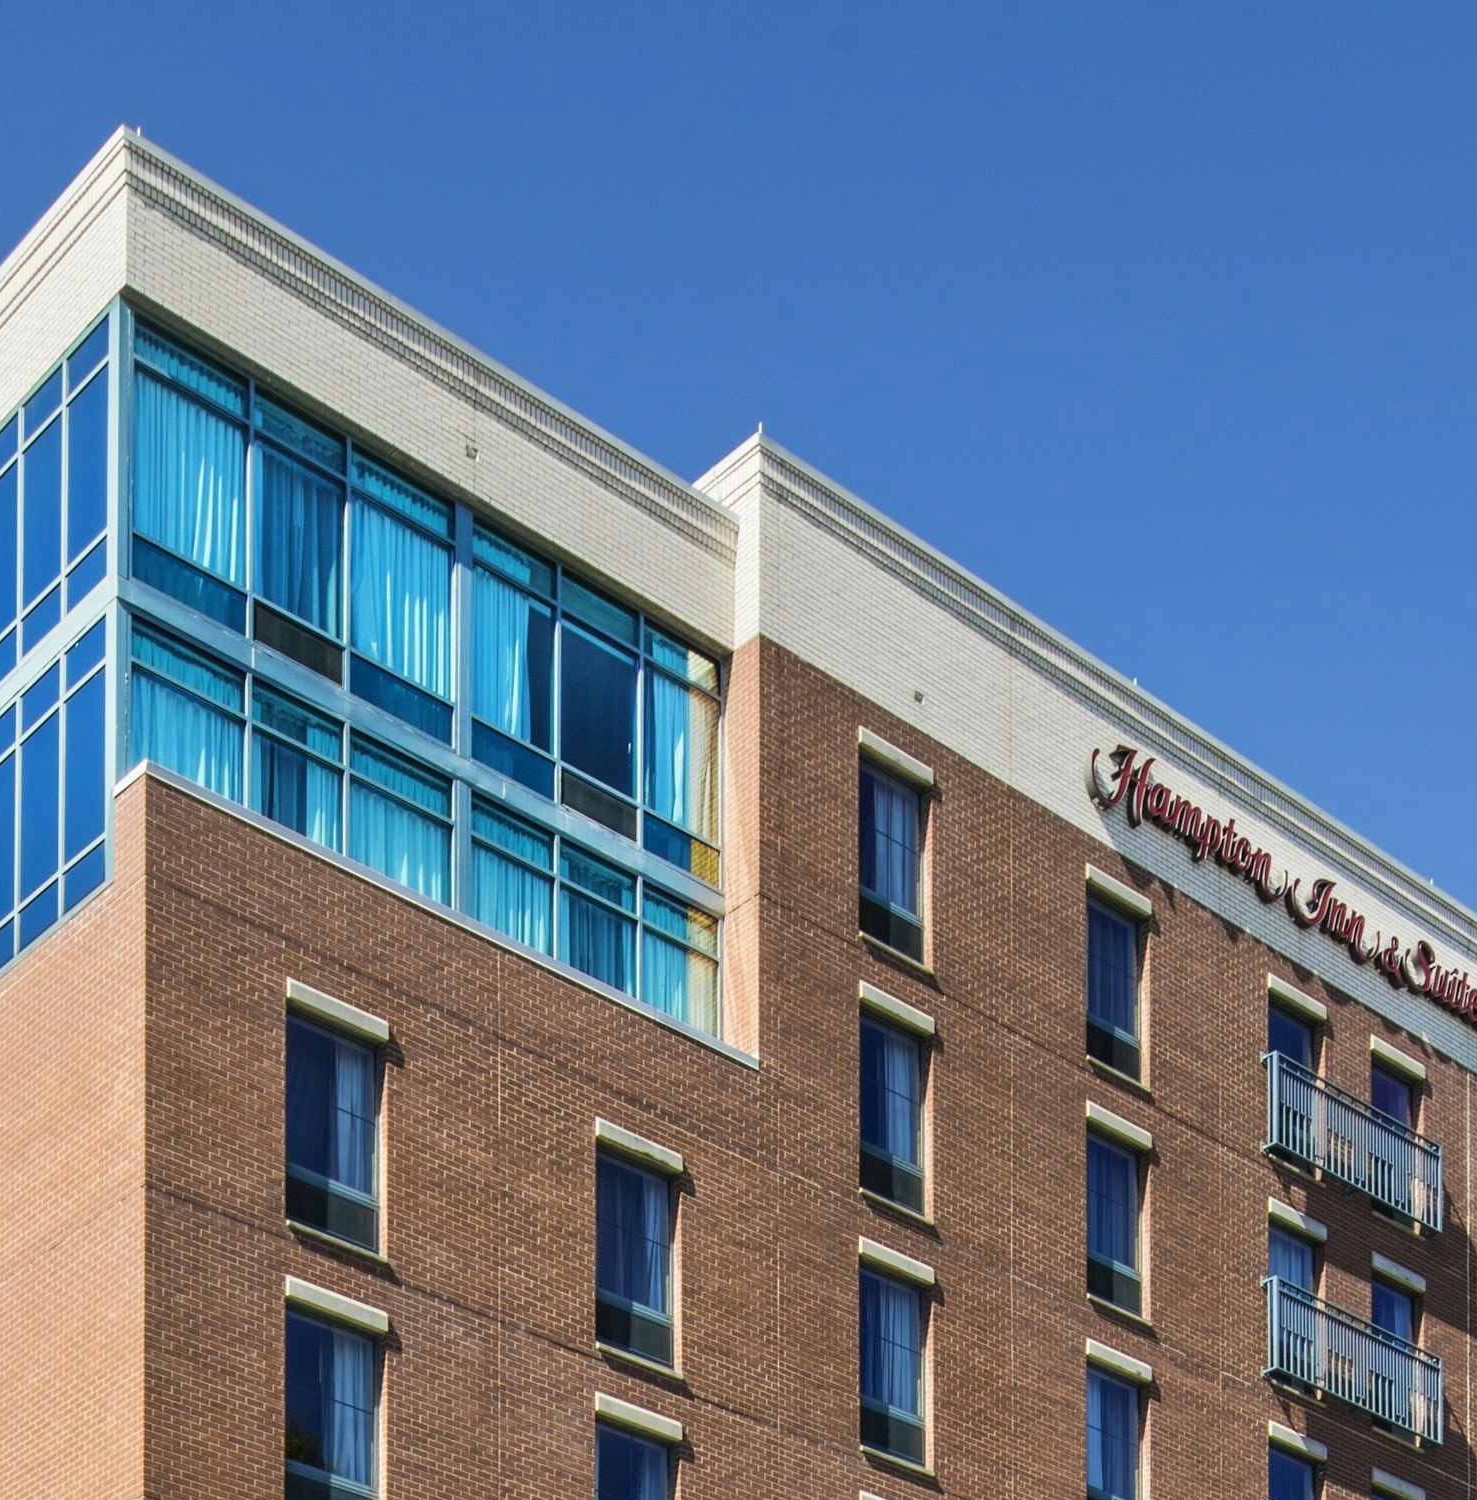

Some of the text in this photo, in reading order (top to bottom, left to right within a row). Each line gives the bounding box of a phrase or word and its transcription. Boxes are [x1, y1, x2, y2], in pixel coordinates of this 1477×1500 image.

[1085, 744, 1288, 901] Hampton
[1286, 878, 1380, 962] Inn
[1379, 936, 1406, 989] &
